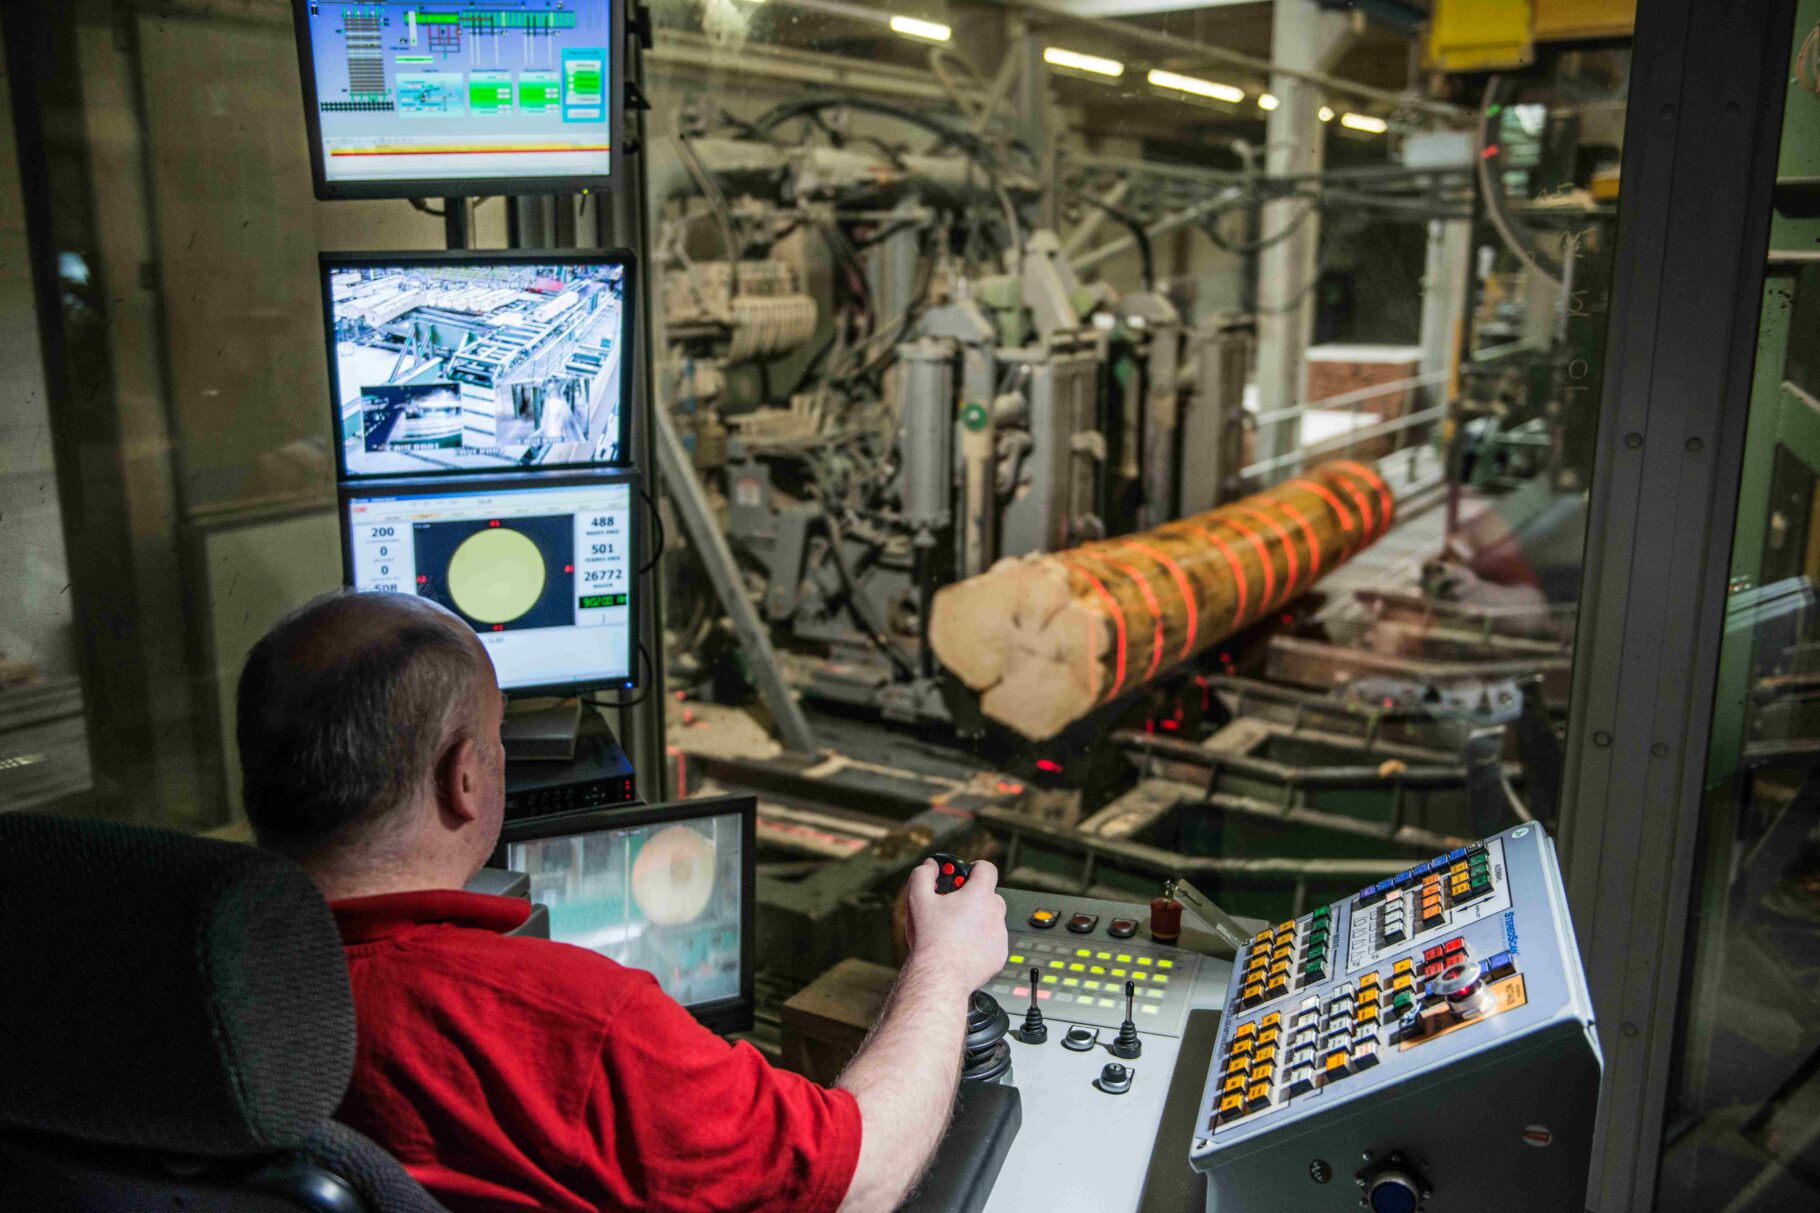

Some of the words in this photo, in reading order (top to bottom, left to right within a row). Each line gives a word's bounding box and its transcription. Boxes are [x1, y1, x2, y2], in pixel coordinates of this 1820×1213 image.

[591, 516, 614, 527] 488
[371, 526, 394, 537] 200
[380, 546, 388, 556] 0
[591, 544, 614, 554] 501
[381, 565, 389, 575] 0
[584, 569, 623, 581] 26772
